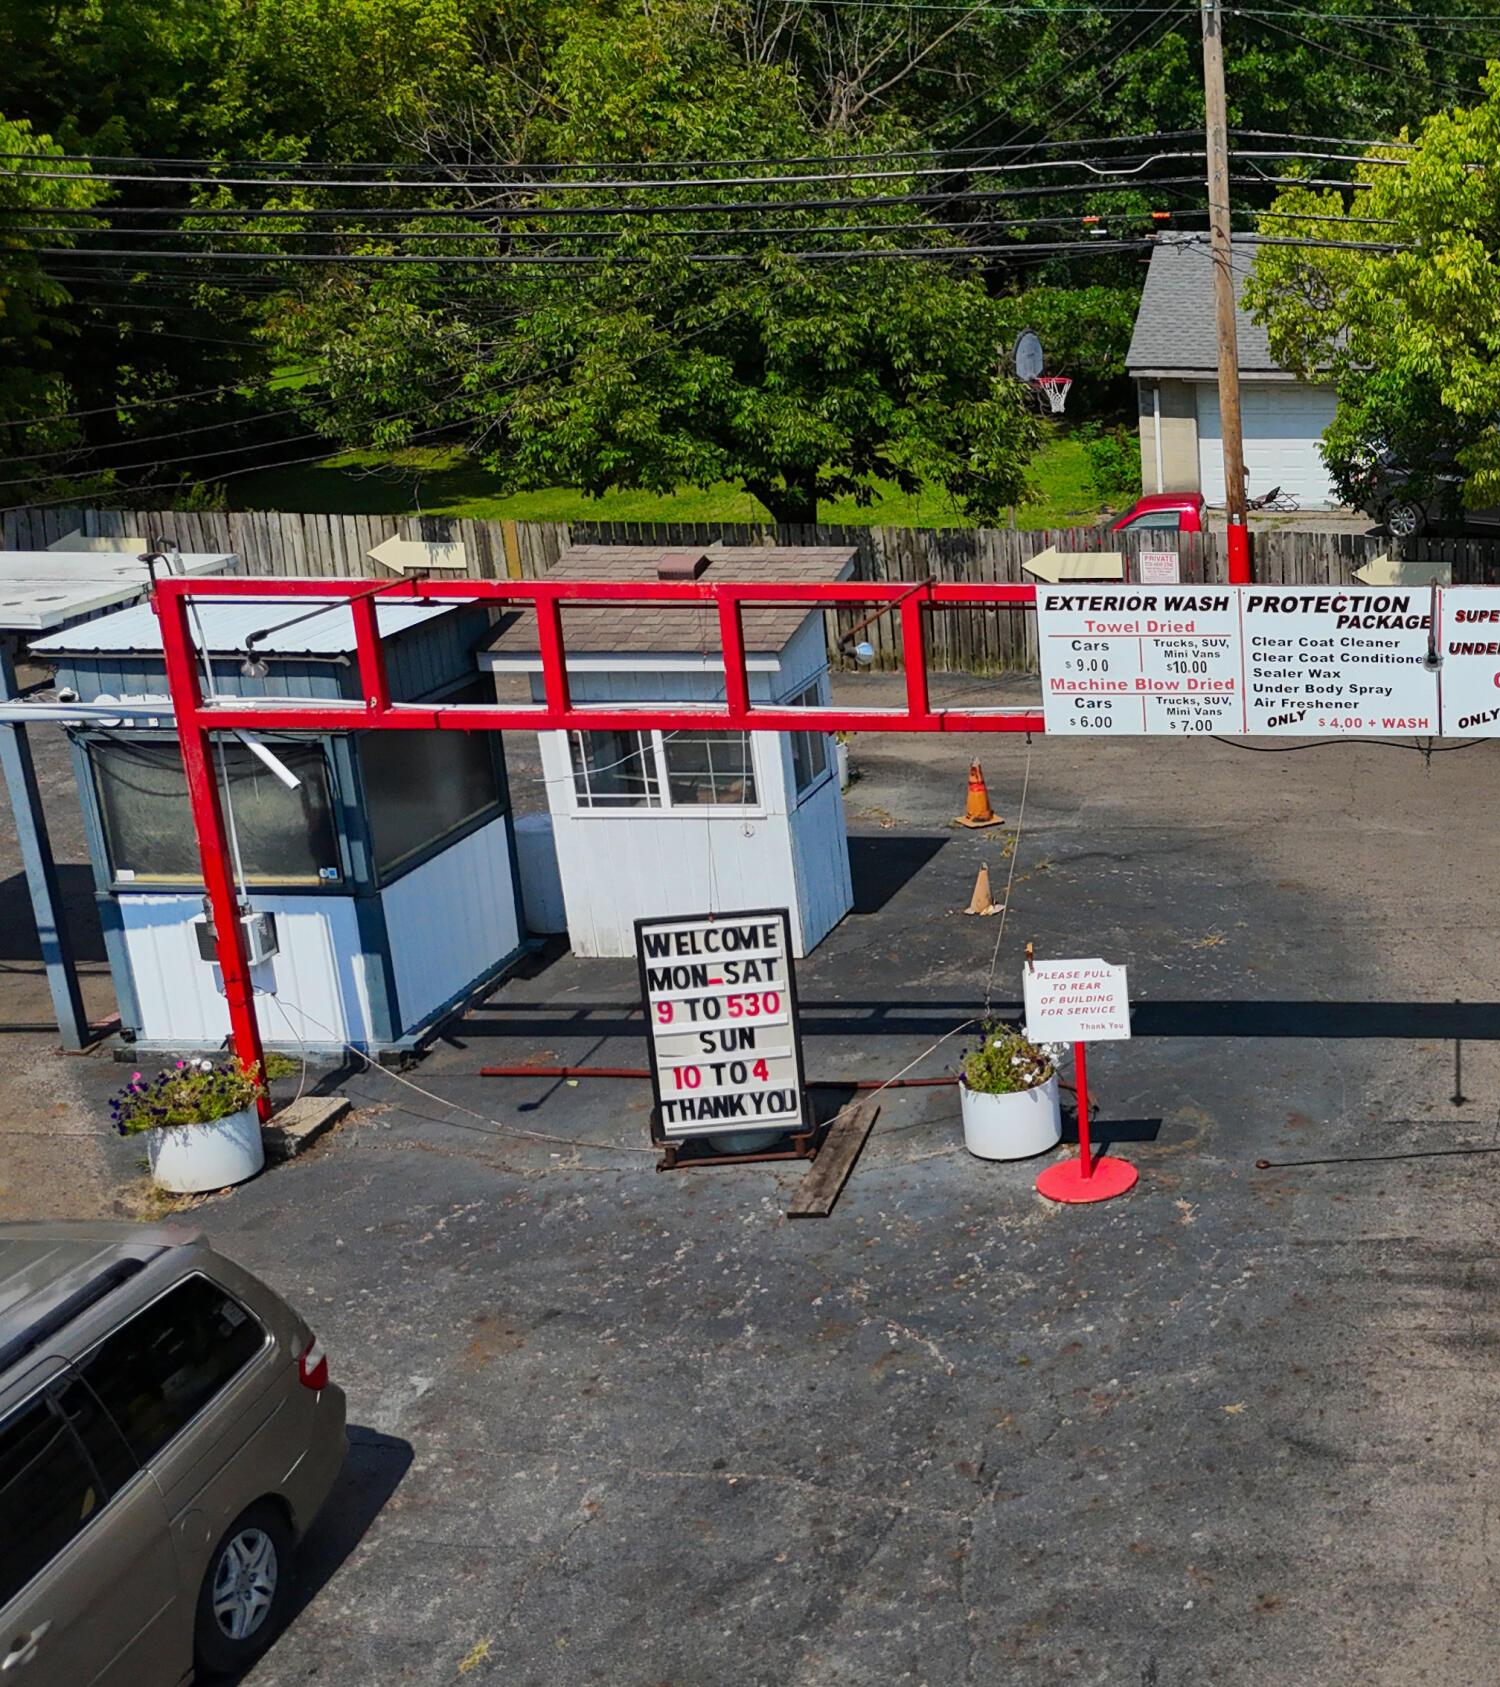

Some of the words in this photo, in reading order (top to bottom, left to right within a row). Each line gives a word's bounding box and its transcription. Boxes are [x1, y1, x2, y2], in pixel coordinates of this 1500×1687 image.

[1045, 596, 1158, 611] EXTERIOR
[1164, 596, 1229, 611] WASH
[1247, 596, 1410, 613] PROTECTION
[1085, 621, 1139, 633] Towel
[1147, 621, 1195, 633] Dried
[1336, 615, 1431, 629] PACKAGE
[1072, 640, 1110, 651] Cars
[1153, 639, 1197, 648] Trucks,
[1202, 639, 1229, 648] SUV,
[1252, 637, 1293, 647] Clear
[1299, 637, 1335, 647] Coat
[1340, 637, 1400, 648] Cleaner
[1164, 650, 1188, 658] Mini
[1192, 650, 1220, 658] Vans
[1252, 653, 1293, 662] Clear
[1299, 653, 1335, 663] Coat
[1340, 653, 1423, 664] Conditione
[1065, 661, 1071, 669] $
[1077, 659, 1109, 672] 9.00
[1167, 661, 1207, 673] $10.00
[1253, 668, 1303, 678] Sealer
[1308, 669, 1341, 678] Wax
[1051, 678, 1128, 690] Machine
[1135, 678, 1179, 690] Blow
[1187, 678, 1235, 690] Dried
[1253, 683, 1299, 693] Under
[1305, 684, 1343, 695] Body
[1349, 684, 1392, 696] Spray
[1074, 698, 1112, 709] Cars
[1156, 697, 1200, 705] Trucks,
[1204, 697, 1231, 705] SUV,
[1254, 698, 1276, 707] Air
[1282, 699, 1359, 709] Freshener
[1070, 718, 1076, 726] $
[1081, 716, 1112, 728] 6.00
[1267, 710, 1306, 727] ONLY
[1318, 719, 1325, 727] $
[1330, 718, 1362, 728] 4.00
[1382, 718, 1428, 728] WASH
[1458, 708, 1500, 728] ONLY
[1170, 721, 1176, 729] $
[1182, 720, 1212, 732] 7.00
[644, 924, 777, 957] WELCOME
[1037, 971, 1080, 980] PLEASE
[1059, 995, 1113, 1004] BUILDING
[657, 1001, 673, 1024] 9
[684, 997, 720, 1021] TO
[727, 991, 780, 1018] 530
[1067, 1006, 1116, 1015] SERVICE
[700, 1027, 755, 1053] SUN
[673, 1065, 701, 1090] 10
[710, 1061, 747, 1086] TO
[752, 1059, 768, 1082] 4
[661, 1095, 747, 1122] THANK
[749, 1090, 797, 1114] YOU
